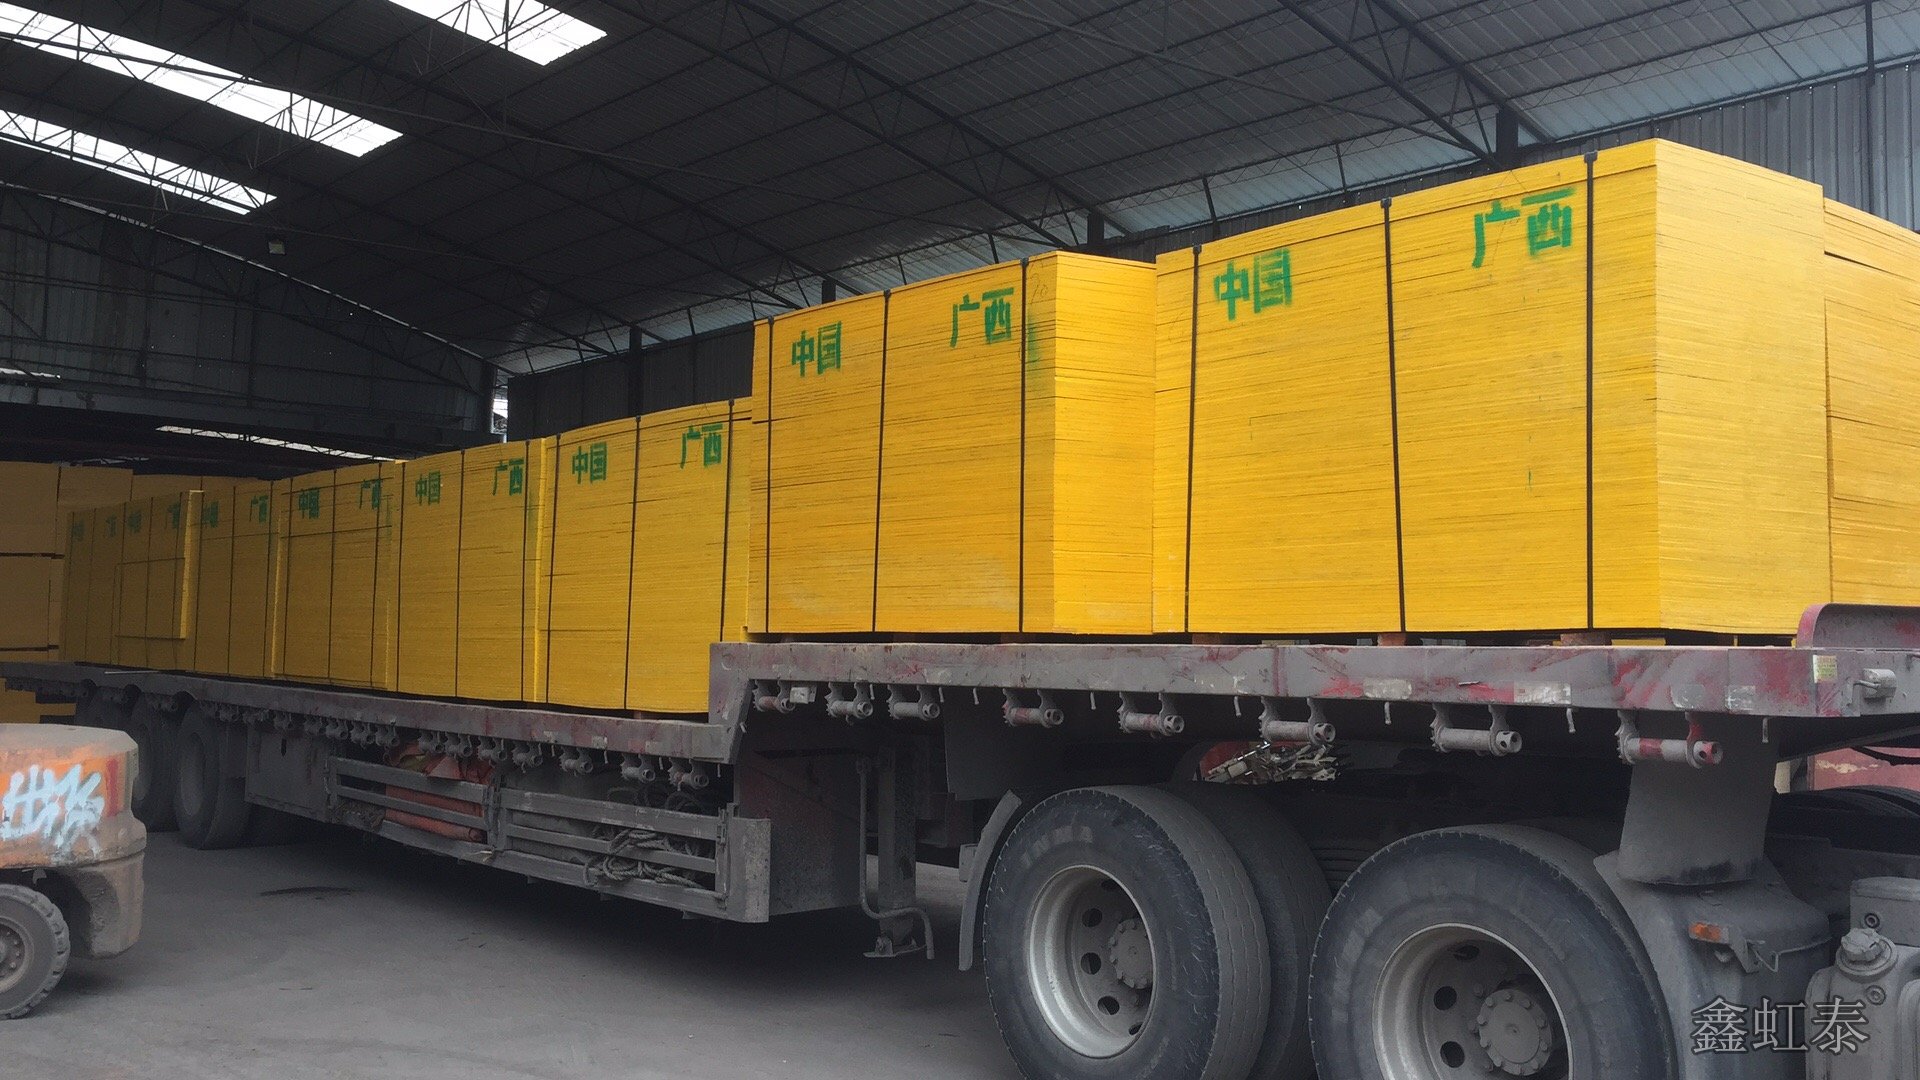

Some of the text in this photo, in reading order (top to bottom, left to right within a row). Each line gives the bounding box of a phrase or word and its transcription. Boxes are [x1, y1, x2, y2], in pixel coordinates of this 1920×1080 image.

[1213, 187, 1576, 321] 中国 广西
[791, 287, 1014, 377] 中国 广西
[415, 459, 525, 505] 中国 广西
[571, 423, 722, 484] 中国 广西
